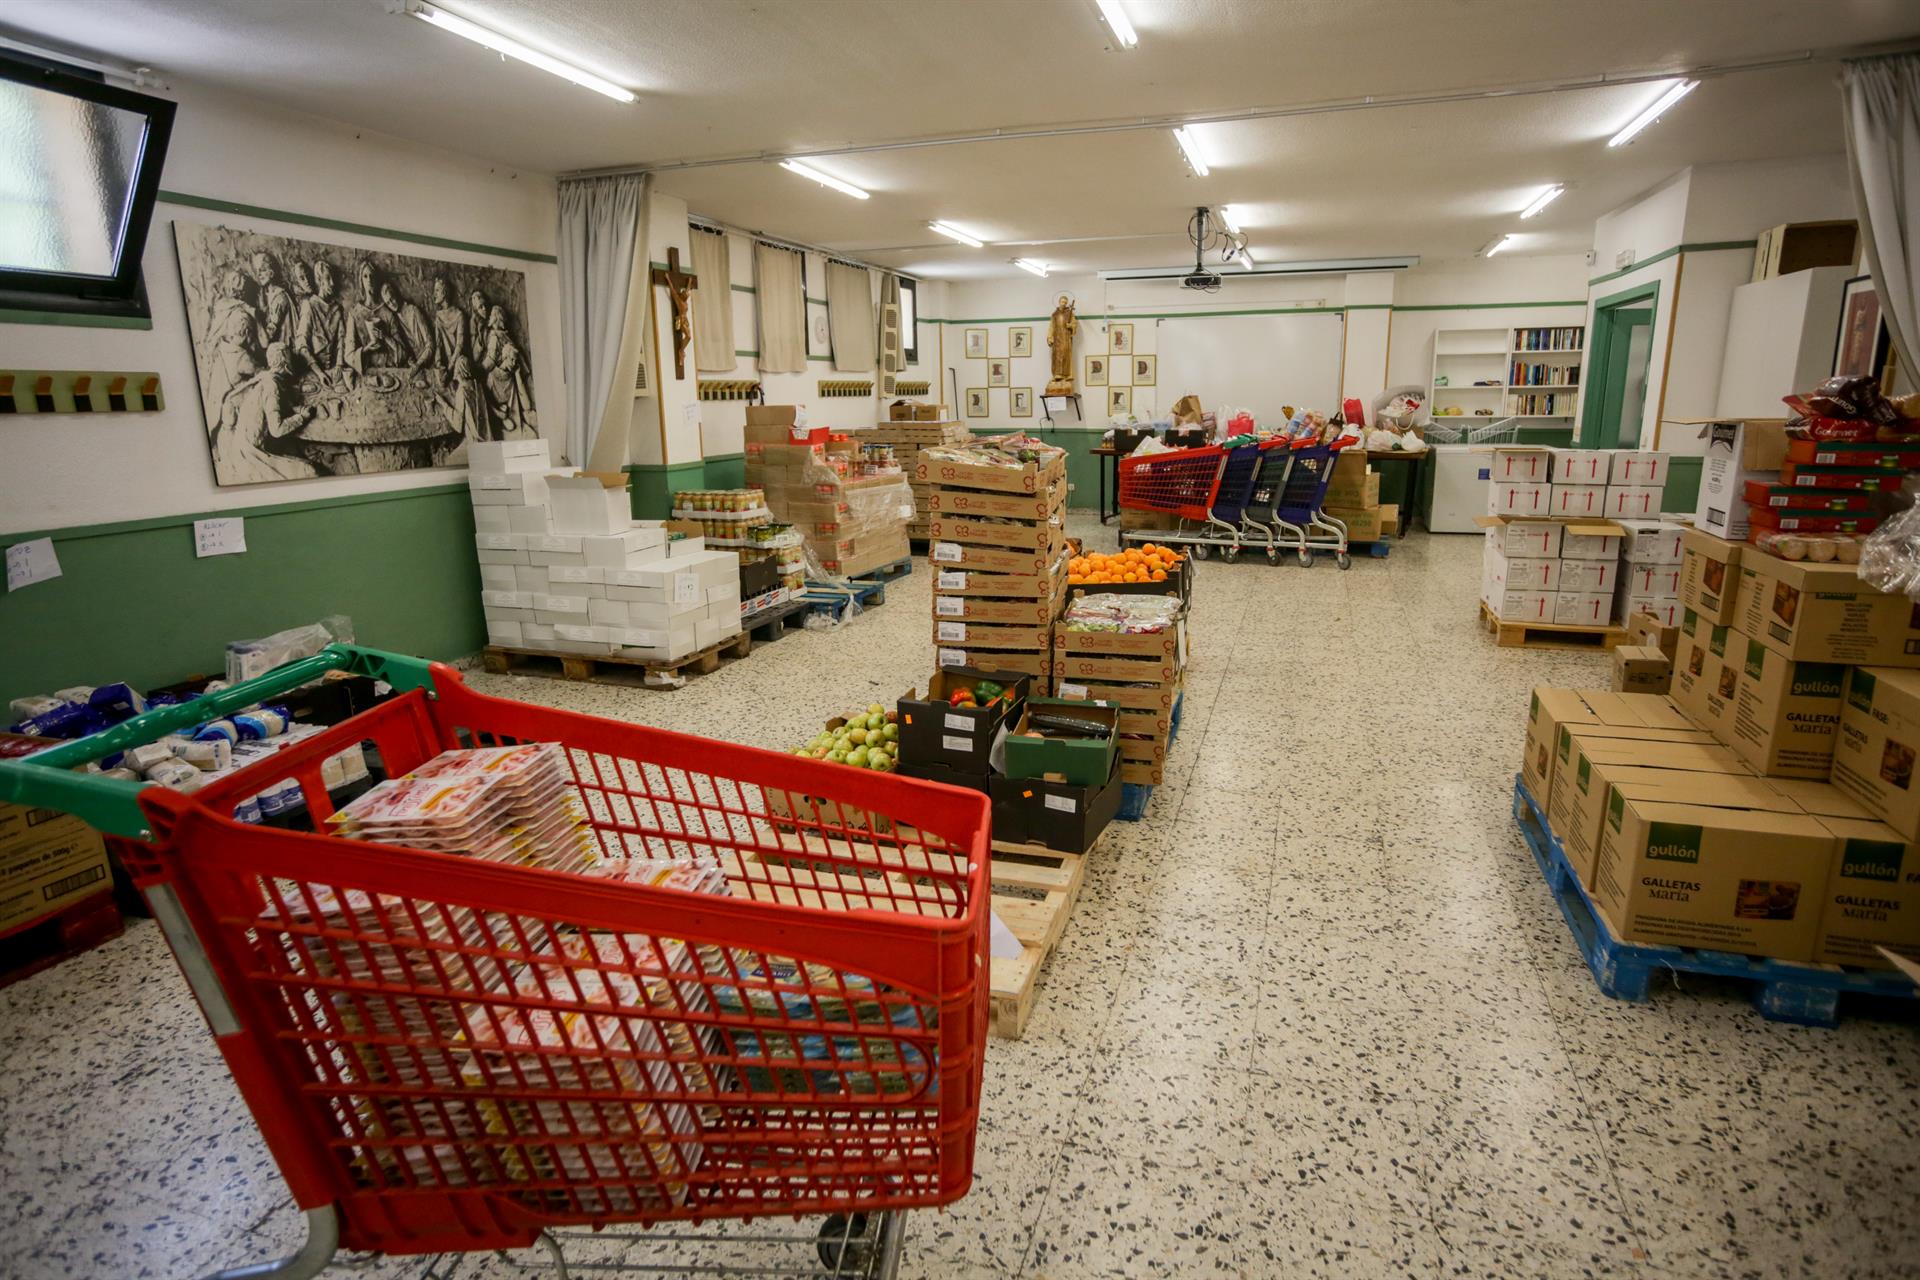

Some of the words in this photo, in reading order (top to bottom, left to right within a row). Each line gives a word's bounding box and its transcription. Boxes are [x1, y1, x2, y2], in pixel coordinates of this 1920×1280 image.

[1793, 679, 1839, 695] gullón
[1649, 844, 1697, 859] gullón
[1845, 860, 1898, 877] gullón
[1642, 876, 1701, 892] GALLETAS
[1834, 894, 1900, 911] GALLETAS
